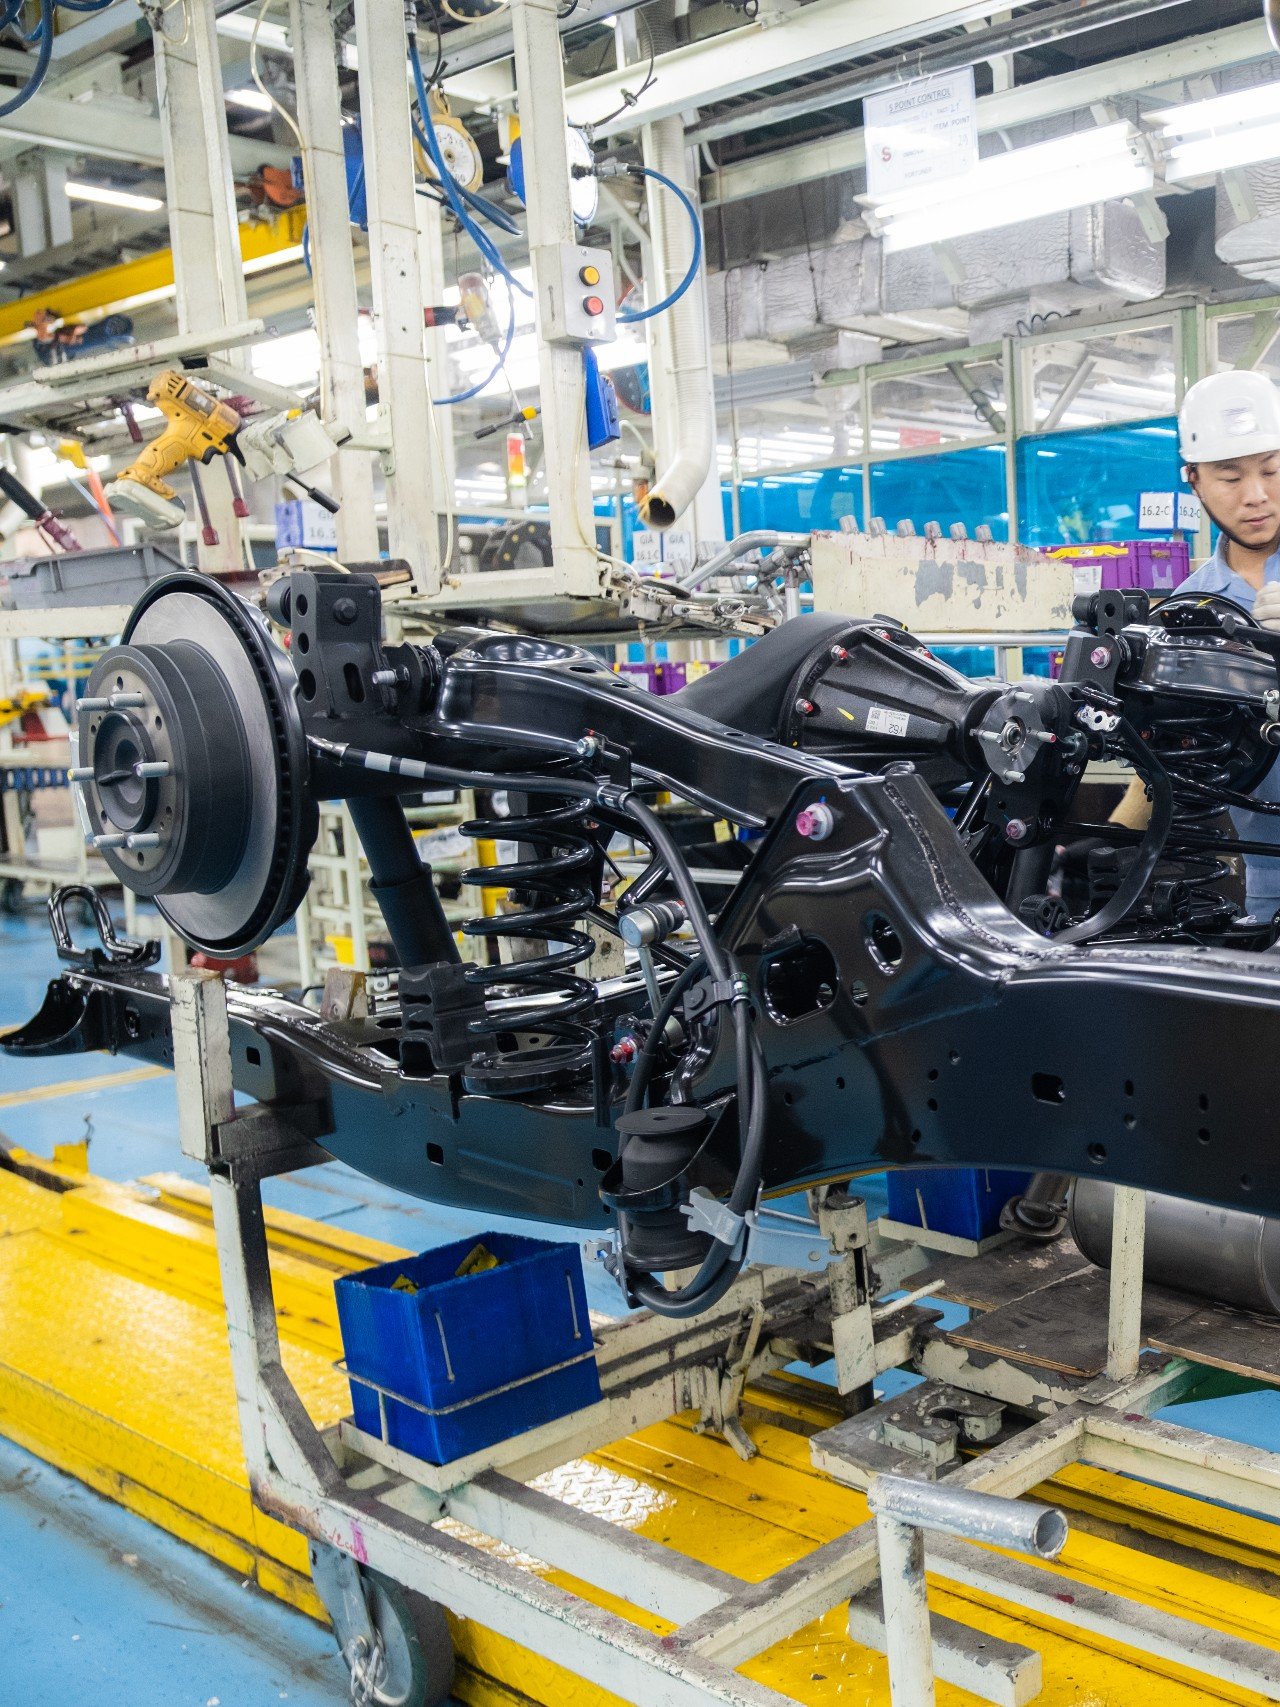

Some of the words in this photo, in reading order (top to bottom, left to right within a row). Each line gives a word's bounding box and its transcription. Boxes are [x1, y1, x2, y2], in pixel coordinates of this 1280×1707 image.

[894, 97, 916, 110] POINT
[918, 88, 951, 104] CONTROL
[951, 115, 970, 127] POINT
[882, 147, 892, 162] S
[1142, 505, 1170, 516] 16.2-C
